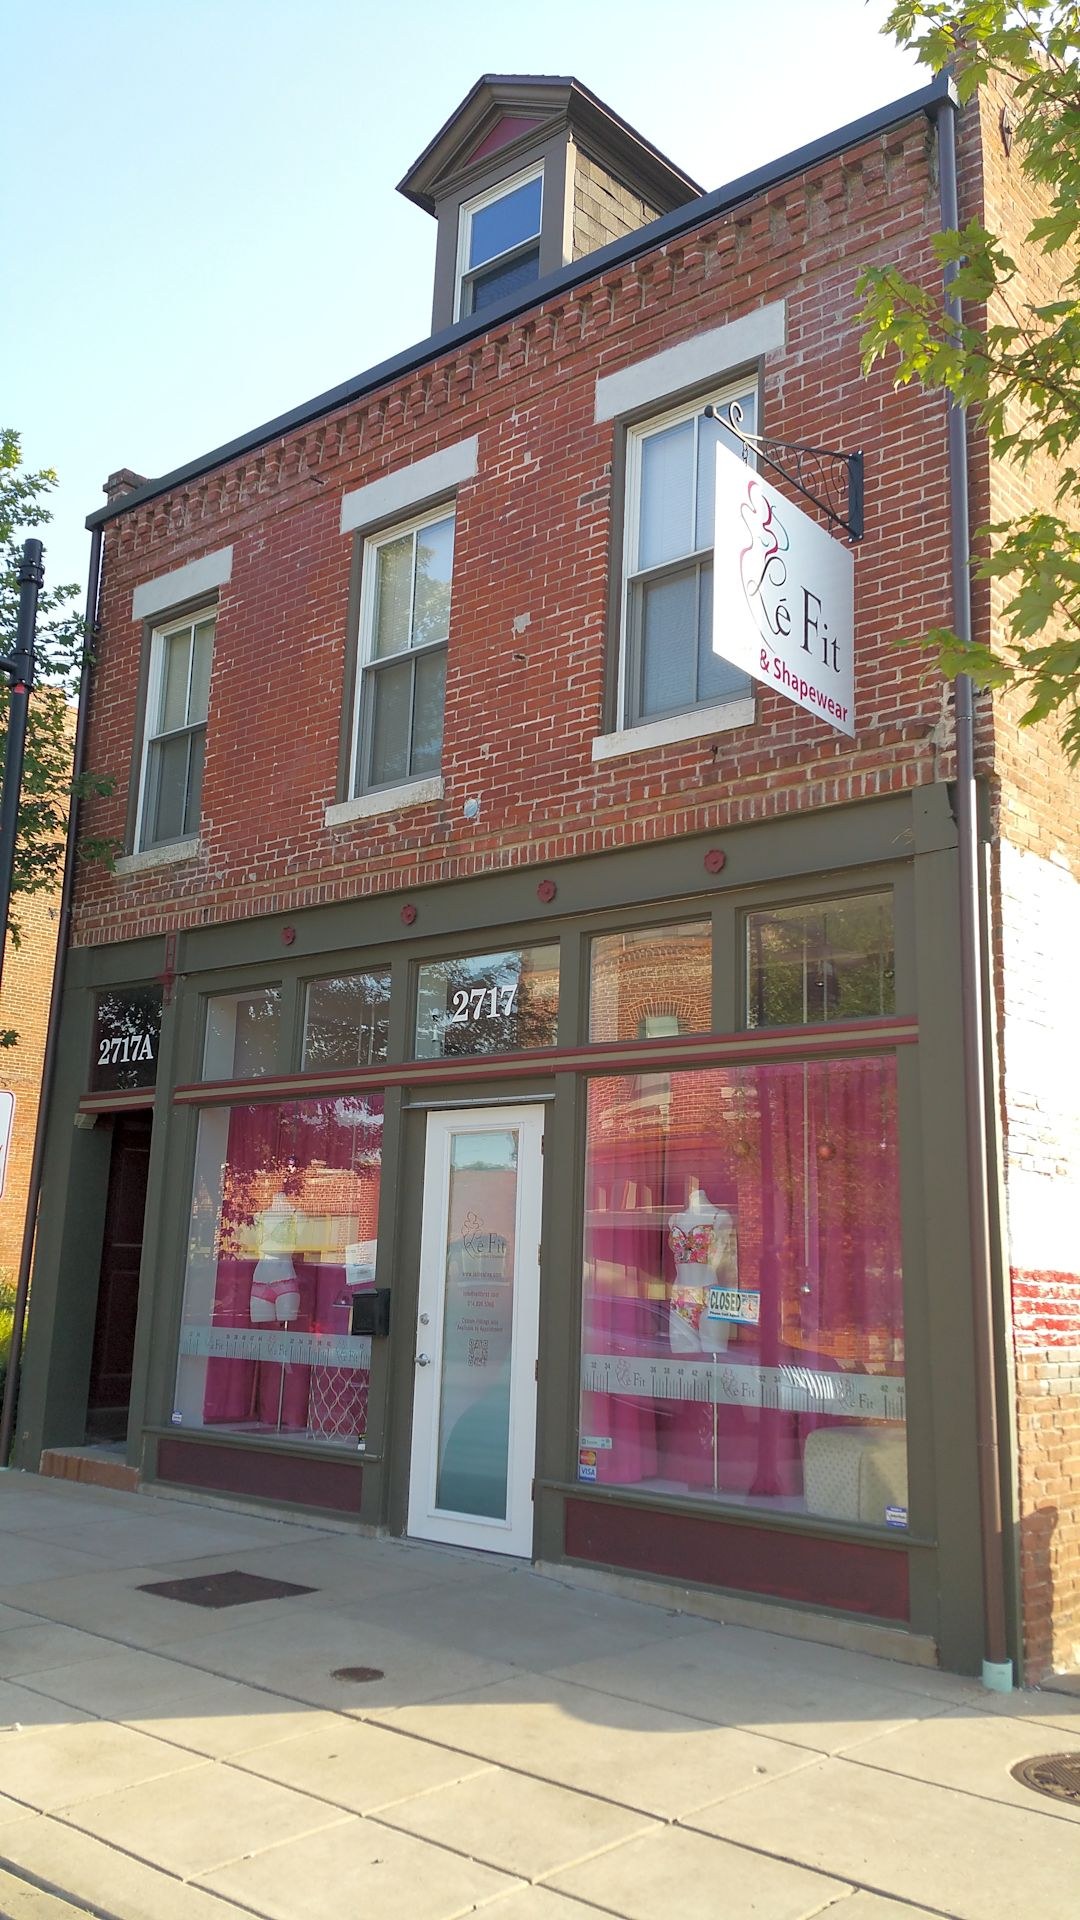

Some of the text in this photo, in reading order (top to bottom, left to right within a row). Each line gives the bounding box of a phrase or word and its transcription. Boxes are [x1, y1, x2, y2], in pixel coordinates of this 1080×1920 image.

[800, 586, 841, 673] Fit
[759, 648, 848, 722] & Shapewear
[452, 983, 518, 1023] 2717
[97, 1034, 154, 1065] 2717A
[488, 1232, 506, 1254] Fit
[710, 1291, 741, 1312] CLOSED
[633, 1371, 645, 1387] Fit
[741, 1381, 755, 1398] Fit
[859, 1393, 874, 1409] Fit
[581, 1466, 595, 1476] VISA
